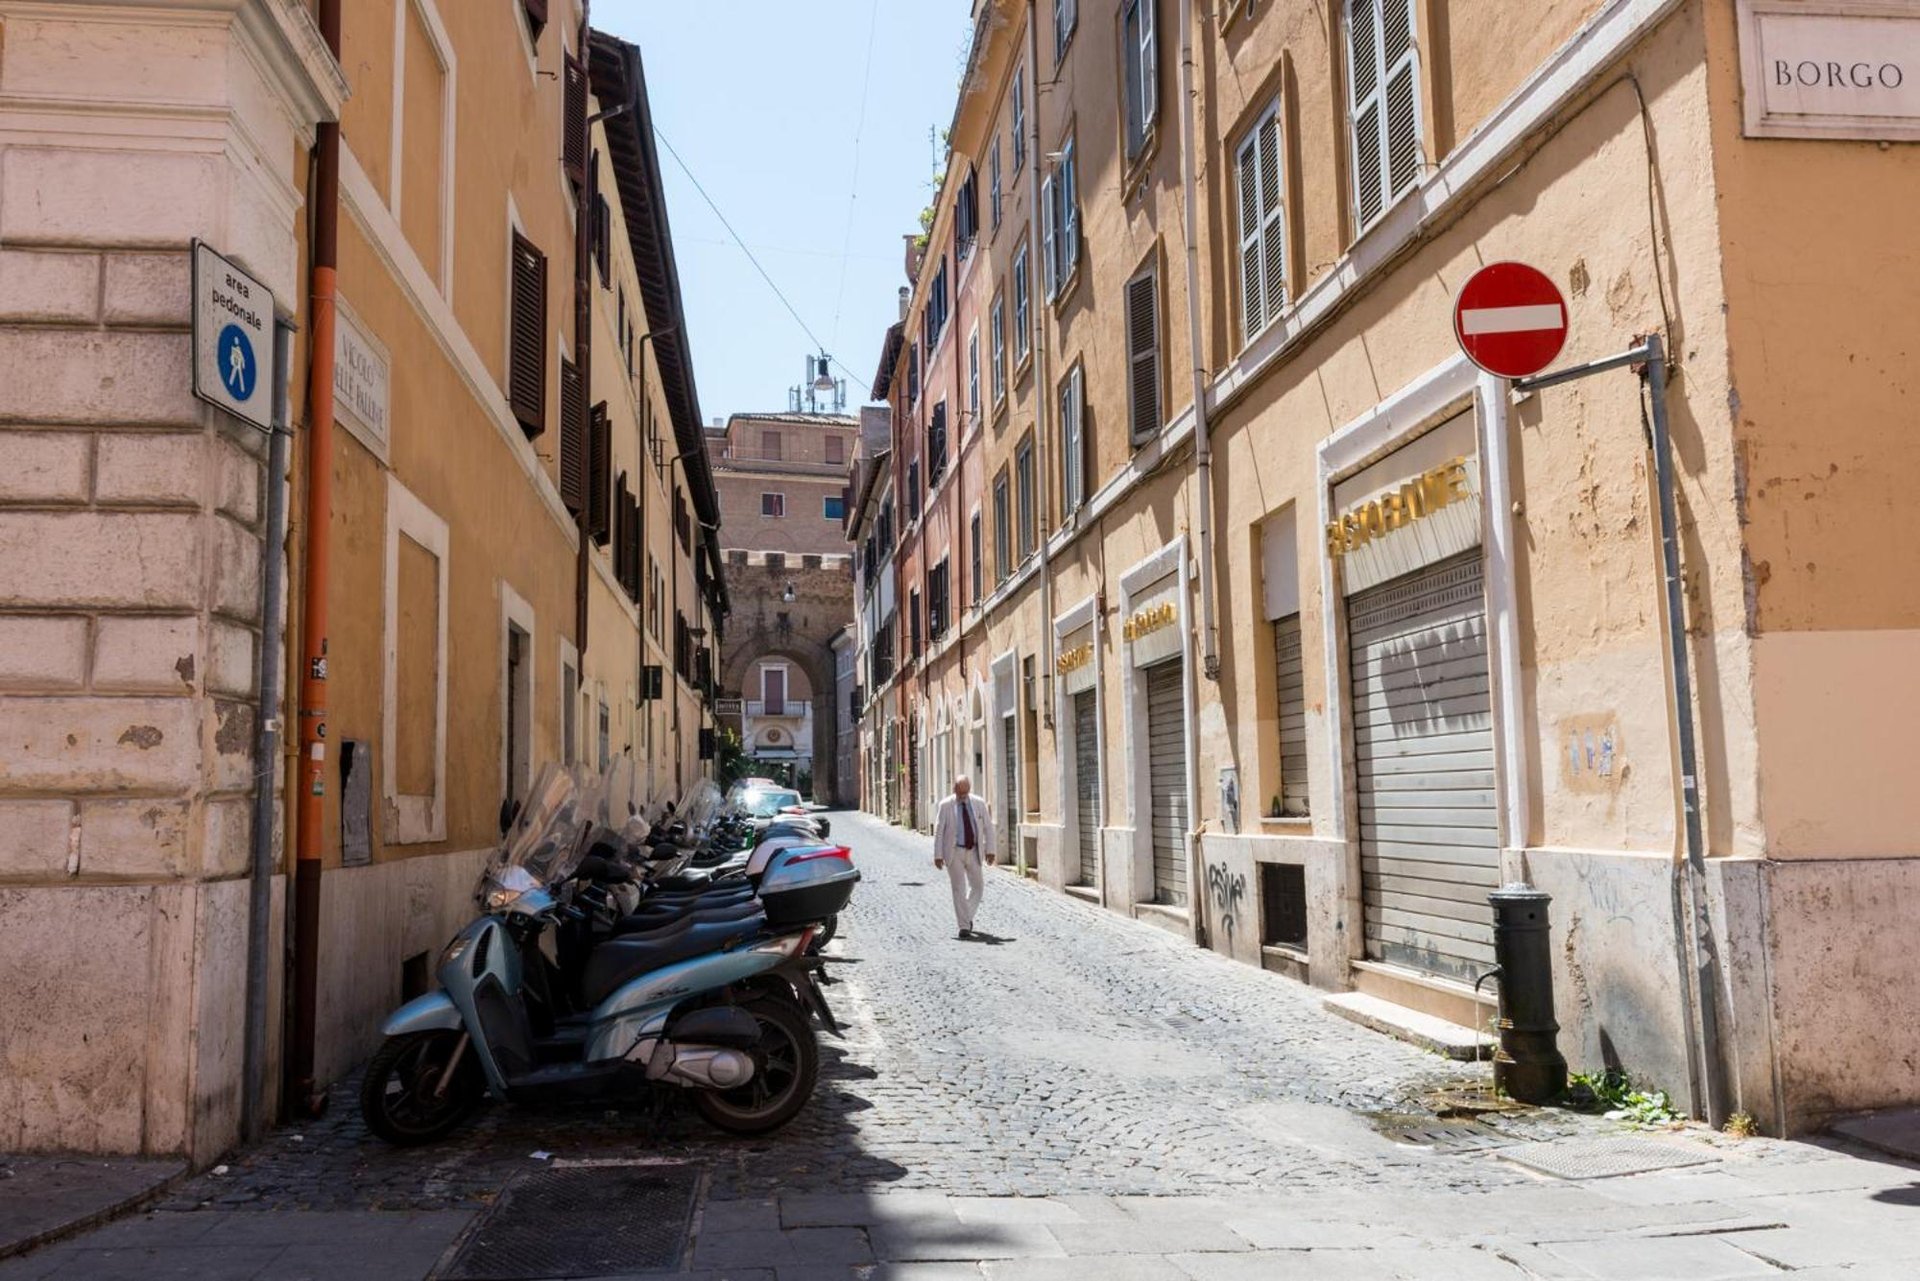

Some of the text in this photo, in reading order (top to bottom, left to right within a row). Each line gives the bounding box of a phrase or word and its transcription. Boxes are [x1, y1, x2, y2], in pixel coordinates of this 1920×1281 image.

[1775, 60, 1903, 89] BORGO
[225, 273, 250, 299] area
[212, 287, 262, 331] pedonale
[342, 333, 374, 386] VICOLO
[334, 364, 354, 402] ELLE
